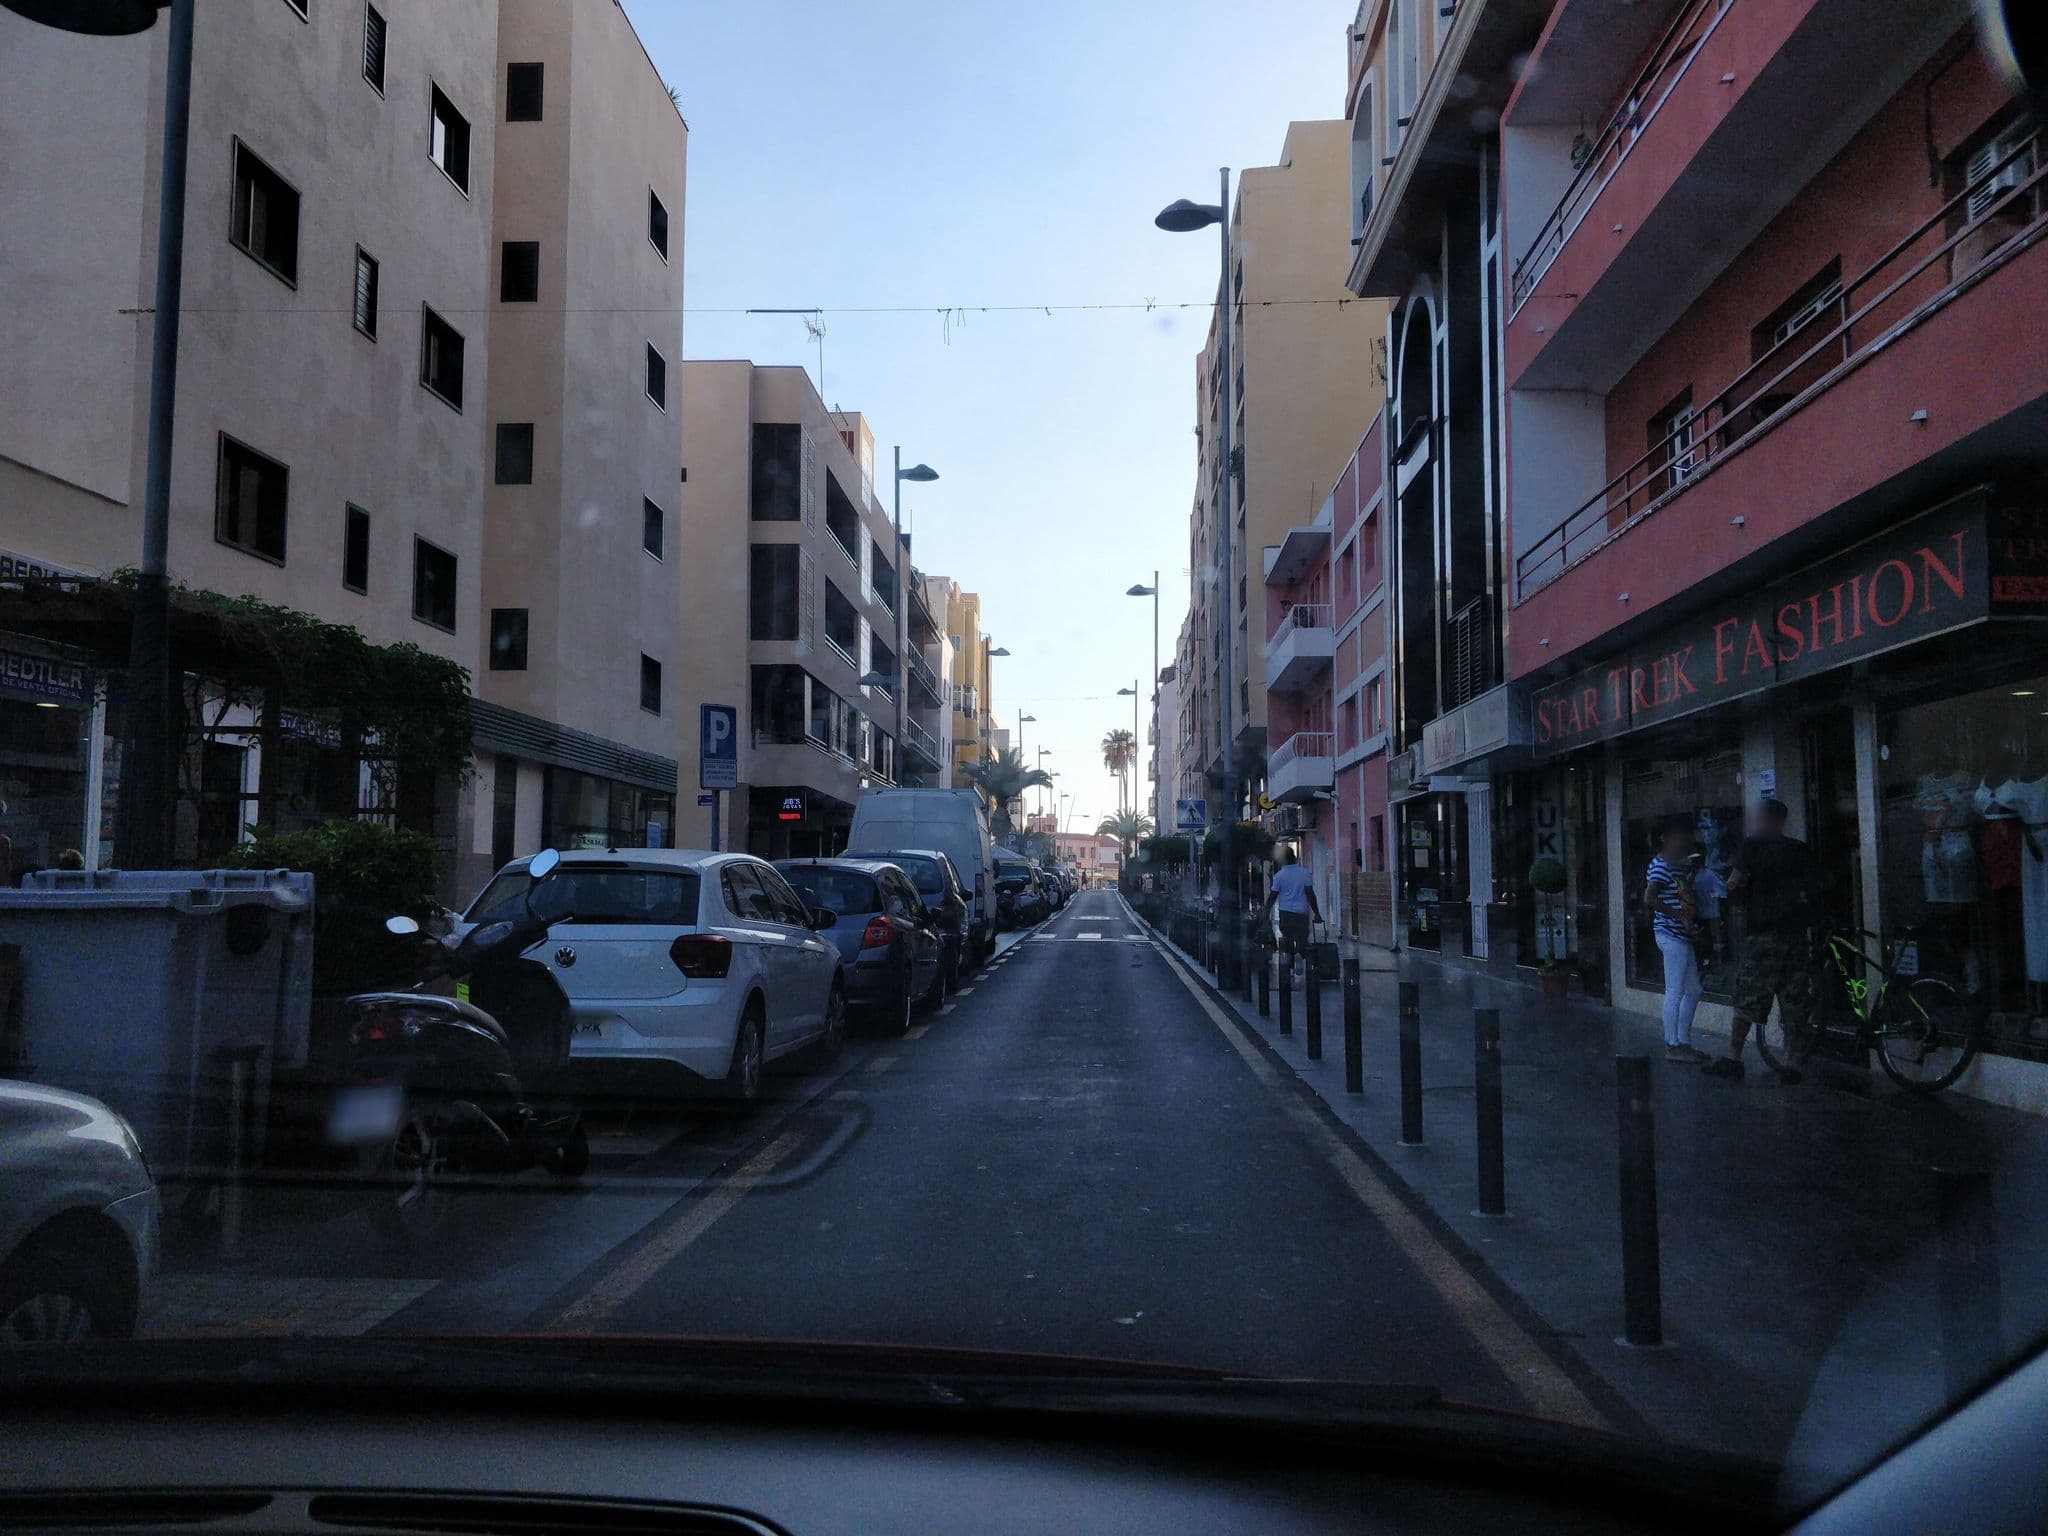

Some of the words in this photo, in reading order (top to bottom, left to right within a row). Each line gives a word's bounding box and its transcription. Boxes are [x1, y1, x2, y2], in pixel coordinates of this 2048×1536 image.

[1537, 687, 1601, 744] STAR
[1608, 644, 1699, 721] TREK
[1713, 528, 1969, 685] FASHION
[710, 711, 731, 754] P
